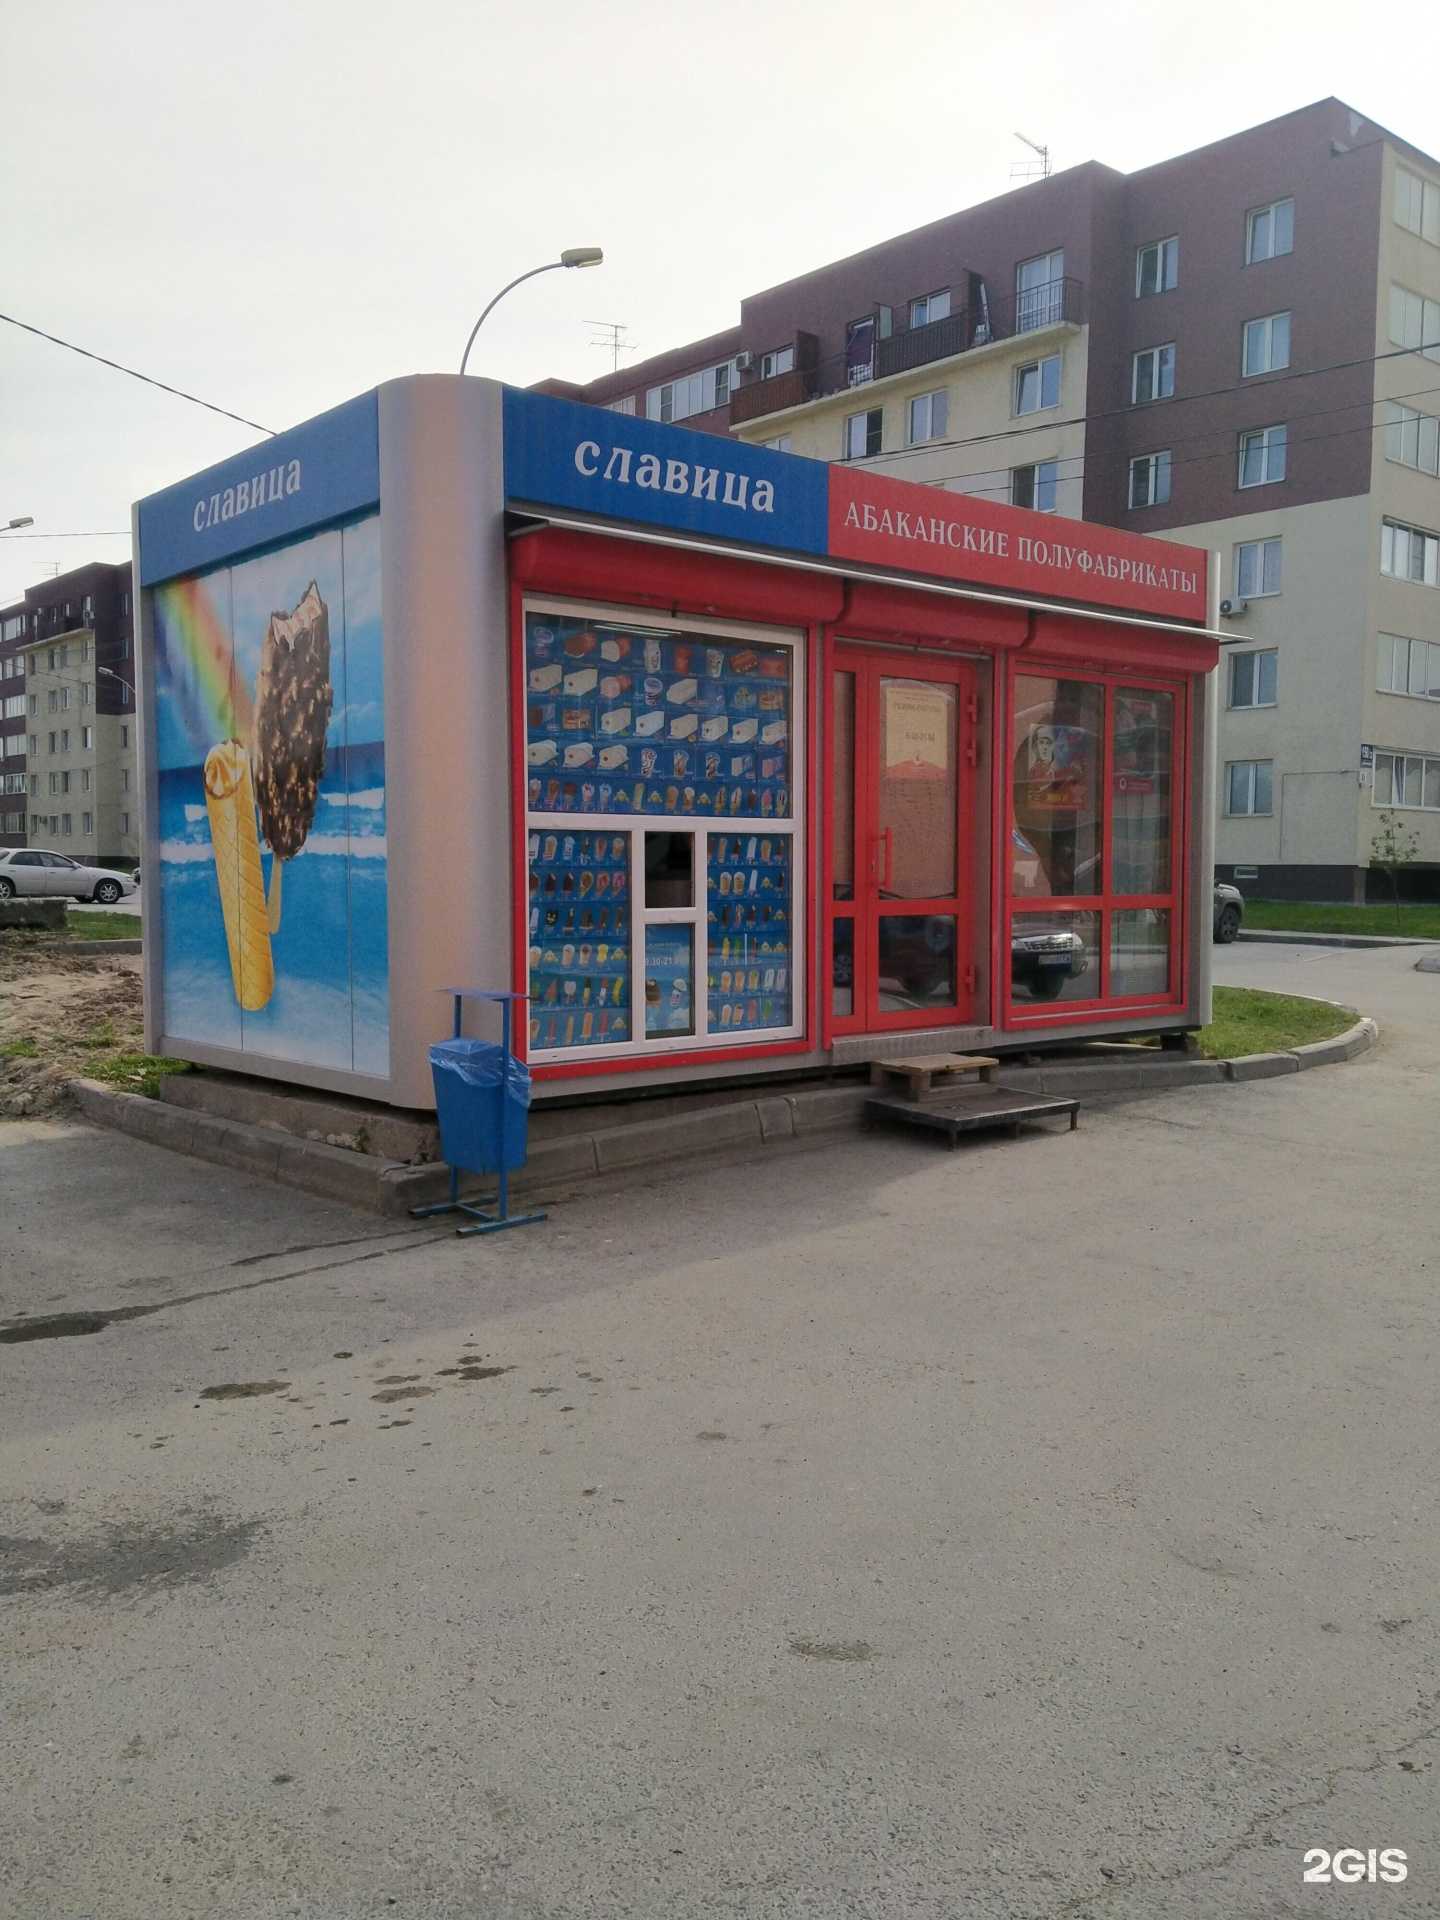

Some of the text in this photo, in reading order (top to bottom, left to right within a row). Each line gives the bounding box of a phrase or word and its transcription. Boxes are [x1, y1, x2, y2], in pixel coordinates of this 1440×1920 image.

[193, 459, 302, 532] славица
[574, 440, 775, 513] славица
[843, 501, 1198, 594] АБАКАНСКИЕ ПОЛУФАБРИКАТЫ
